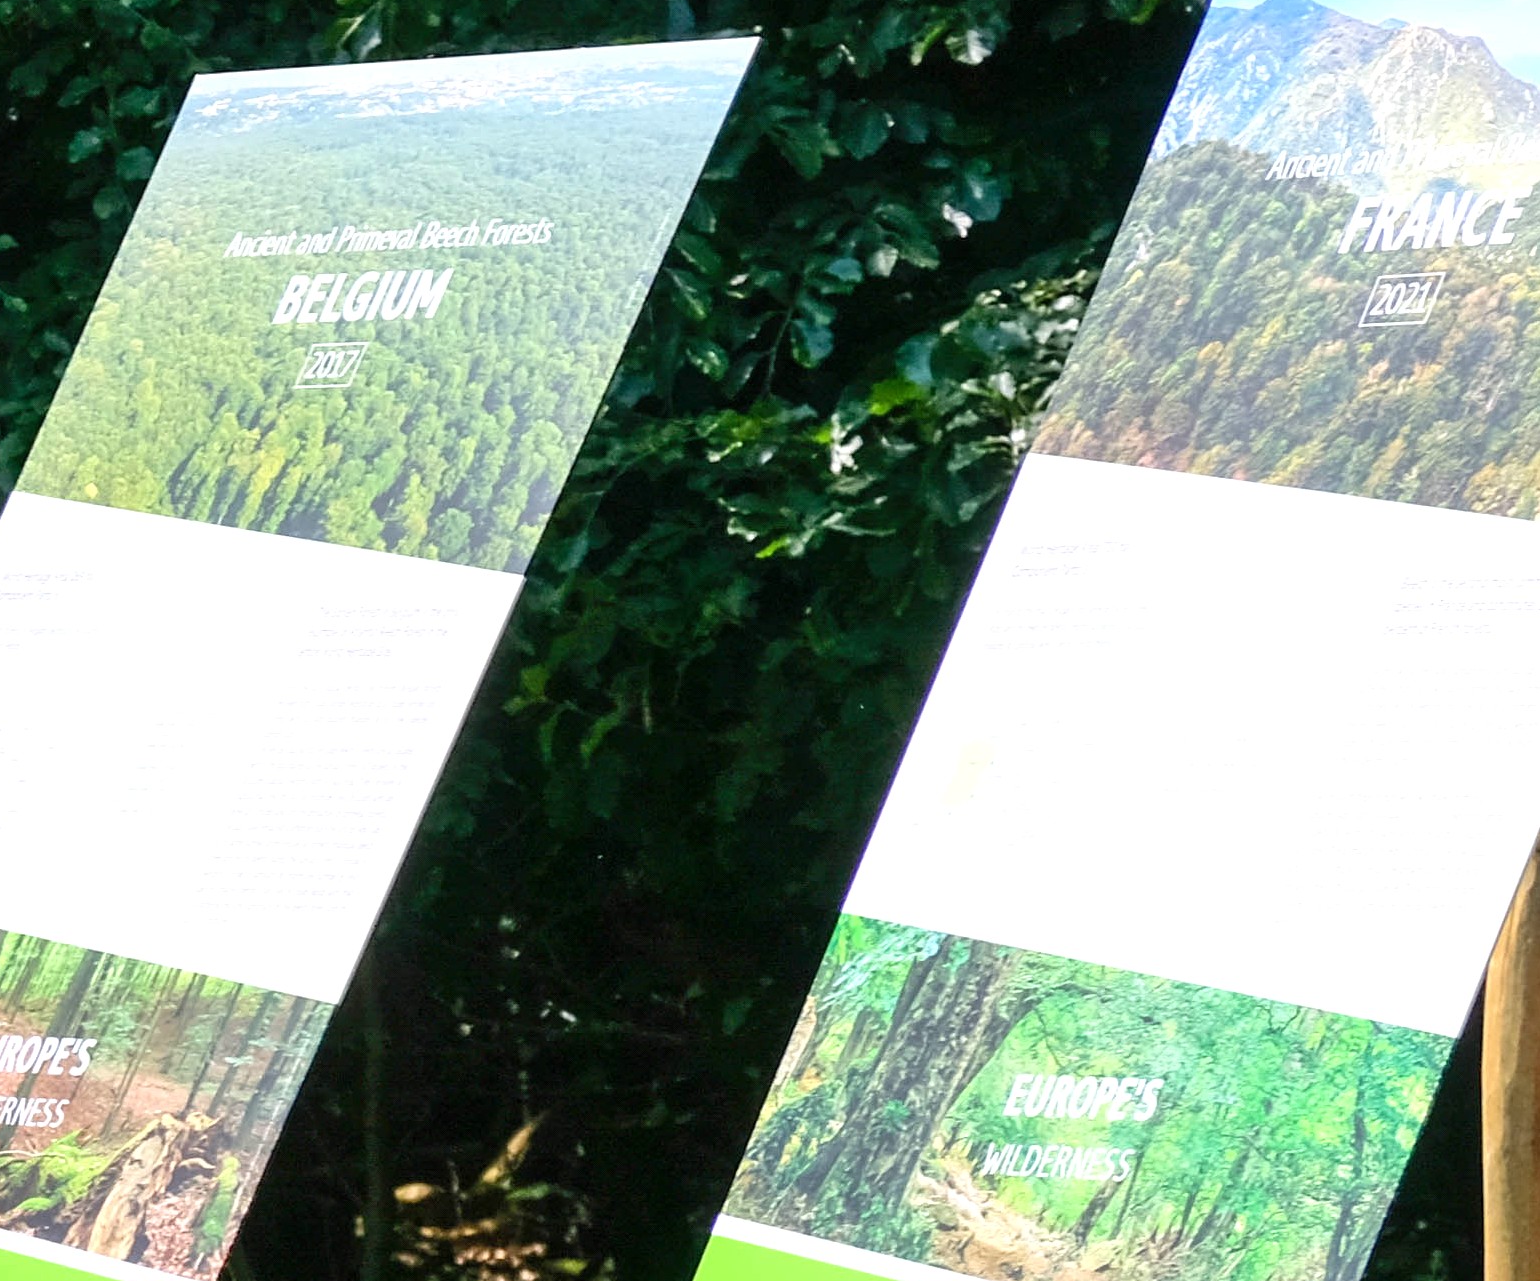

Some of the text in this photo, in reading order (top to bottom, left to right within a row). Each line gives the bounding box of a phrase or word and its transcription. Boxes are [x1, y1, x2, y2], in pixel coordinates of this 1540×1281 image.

[1265, 147, 1352, 180] Ancient
[223, 217, 555, 258] Ancient and Primeval Beech Forests
[1338, 185, 1533, 254] FRANCE
[272, 269, 454, 325] BELGIUM
[1369, 281, 1432, 316] 2021
[304, 350, 360, 379] 2017
[1003, 1073, 1164, 1121] EUROPE'S
[980, 1142, 1135, 1182] WILDERNESS
